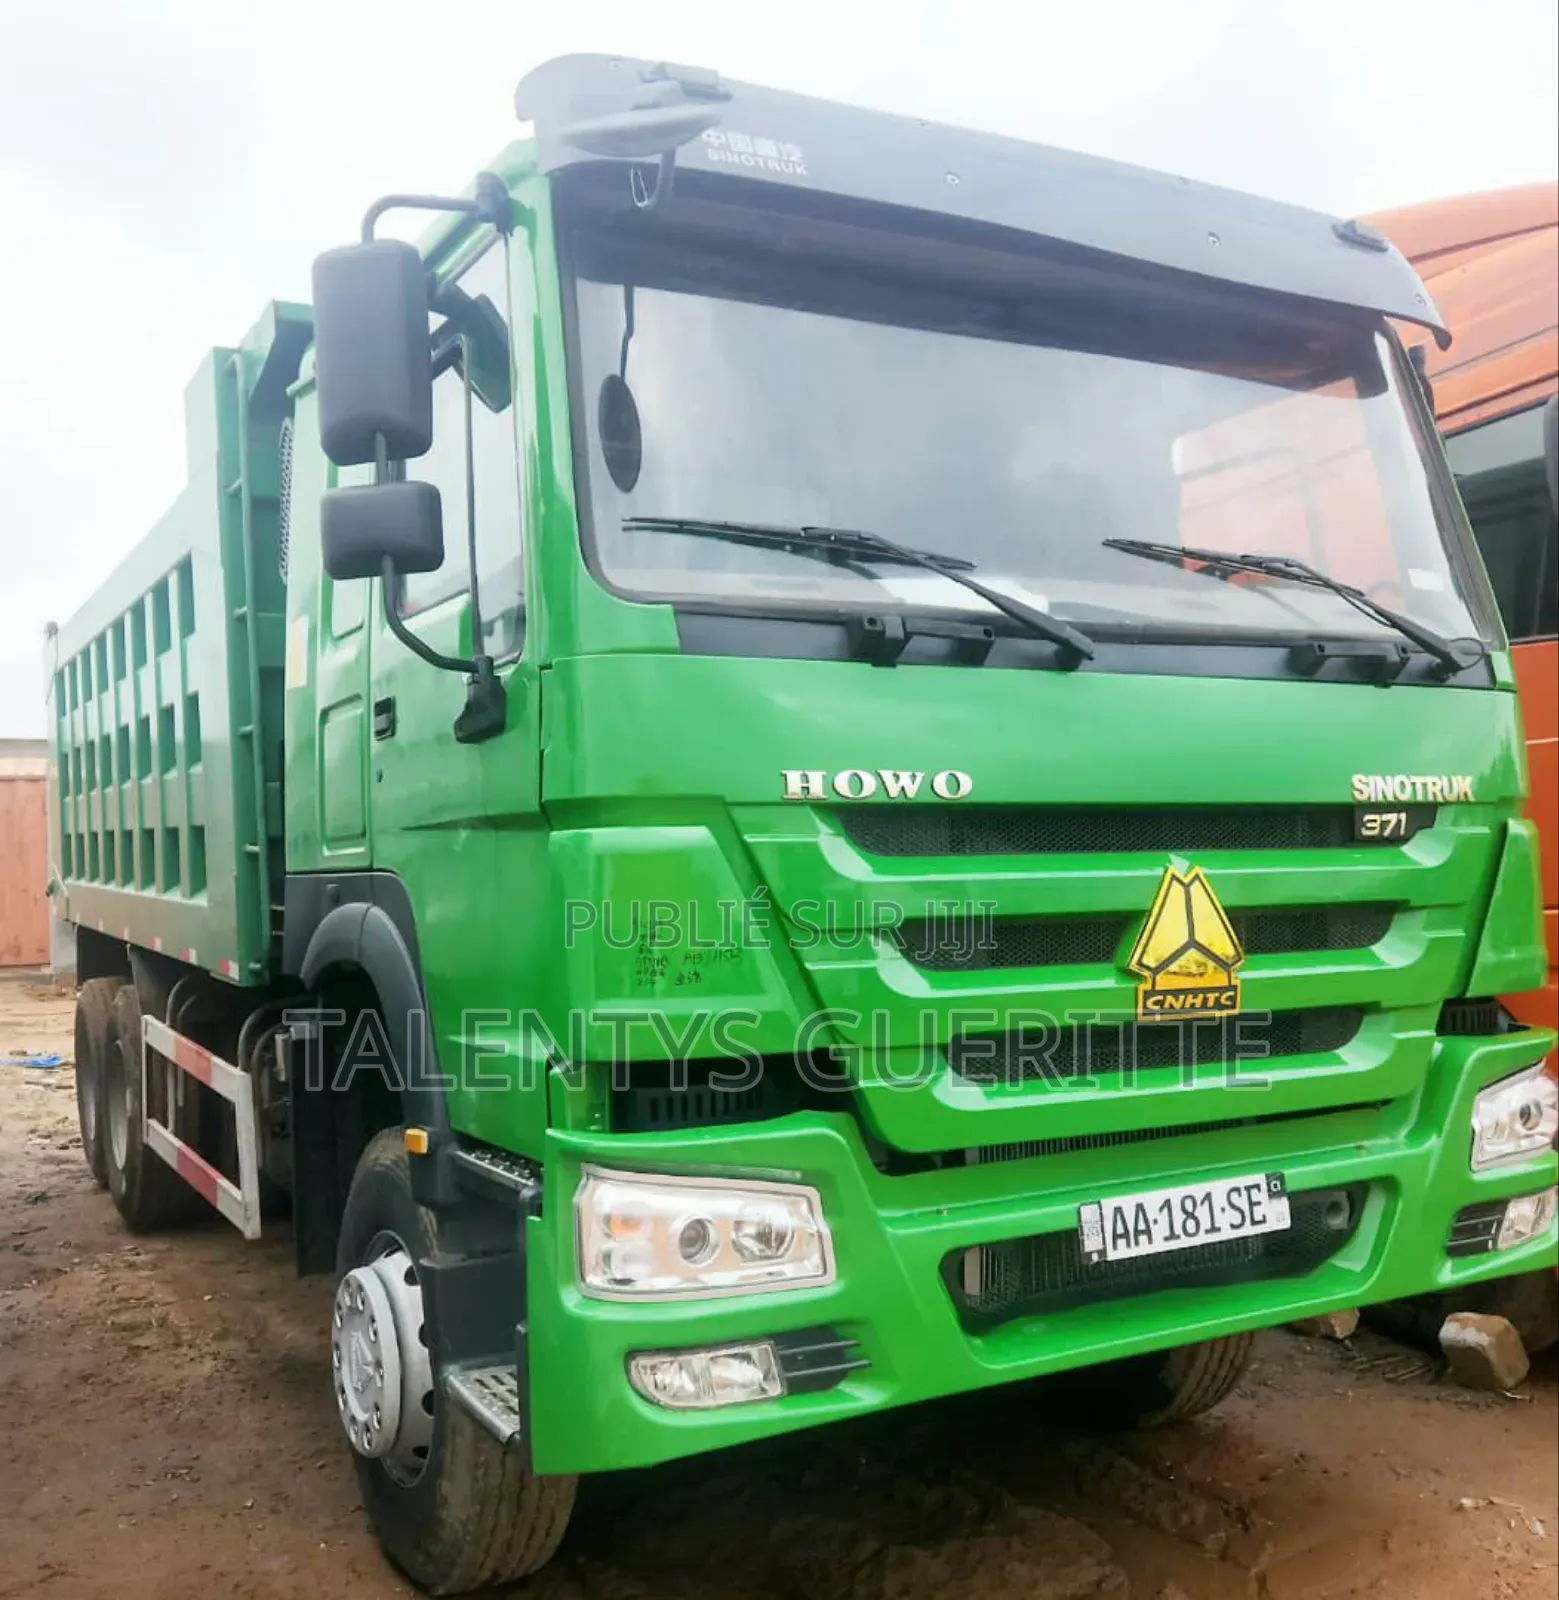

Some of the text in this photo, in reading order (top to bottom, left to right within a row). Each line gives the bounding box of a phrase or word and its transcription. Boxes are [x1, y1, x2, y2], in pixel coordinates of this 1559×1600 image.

[781, 769, 973, 800] HOWO
[1352, 775, 1474, 802] SINOTRUK
[1361, 812, 1407, 836] 371
[1146, 992, 1235, 1010] CNHTC
